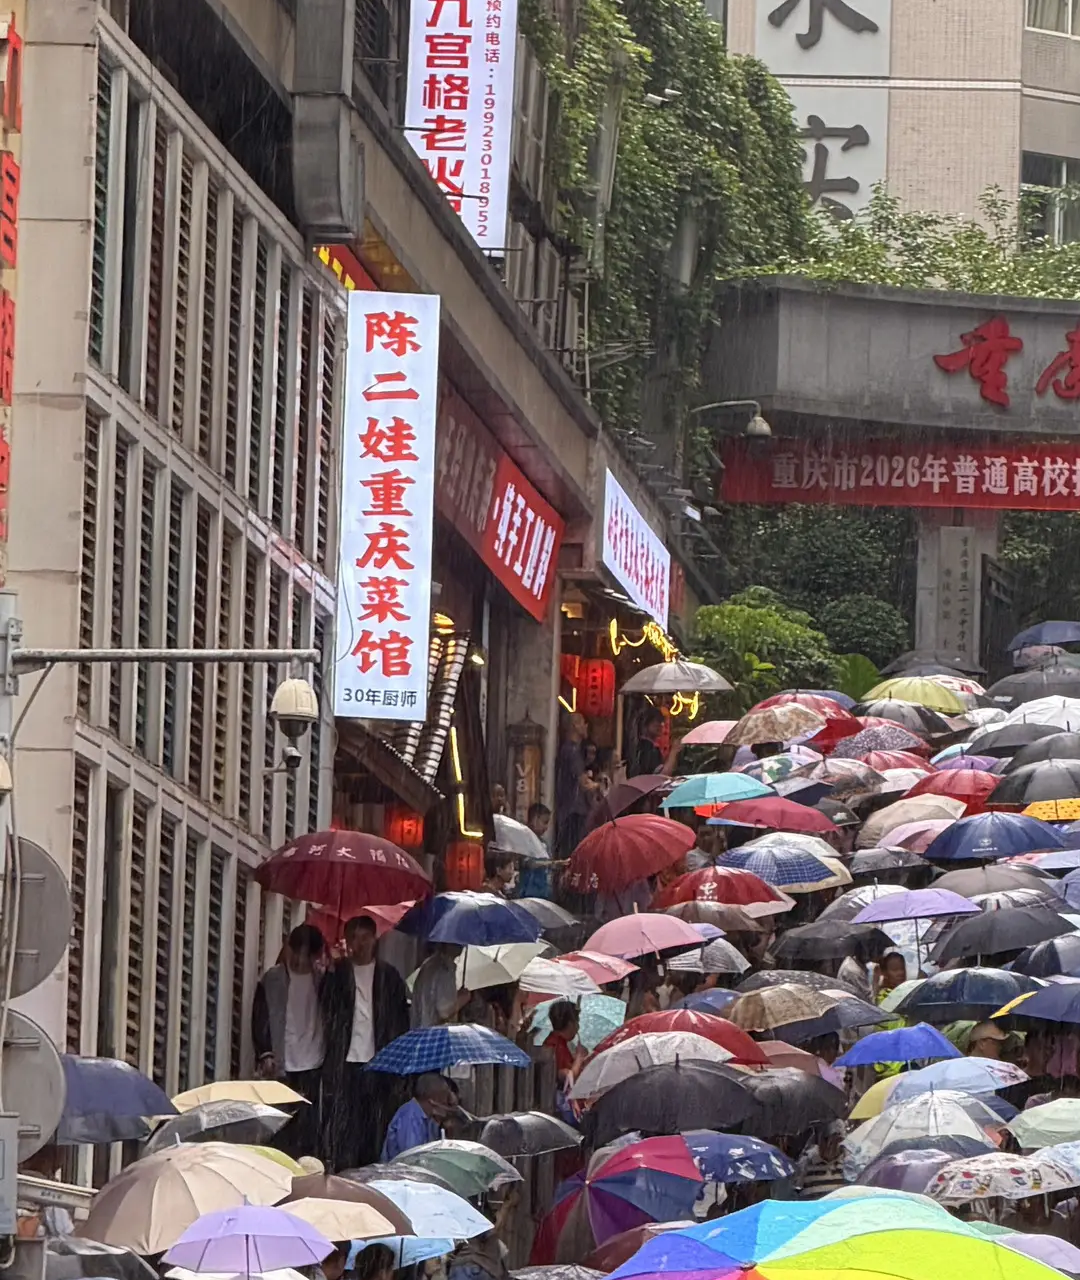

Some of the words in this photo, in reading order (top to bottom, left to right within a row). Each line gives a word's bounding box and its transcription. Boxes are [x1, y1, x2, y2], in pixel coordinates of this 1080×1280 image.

[351, 310, 423, 679] 陈二娃重庆菜馆
[342, 687, 418, 708] 30年厨师
